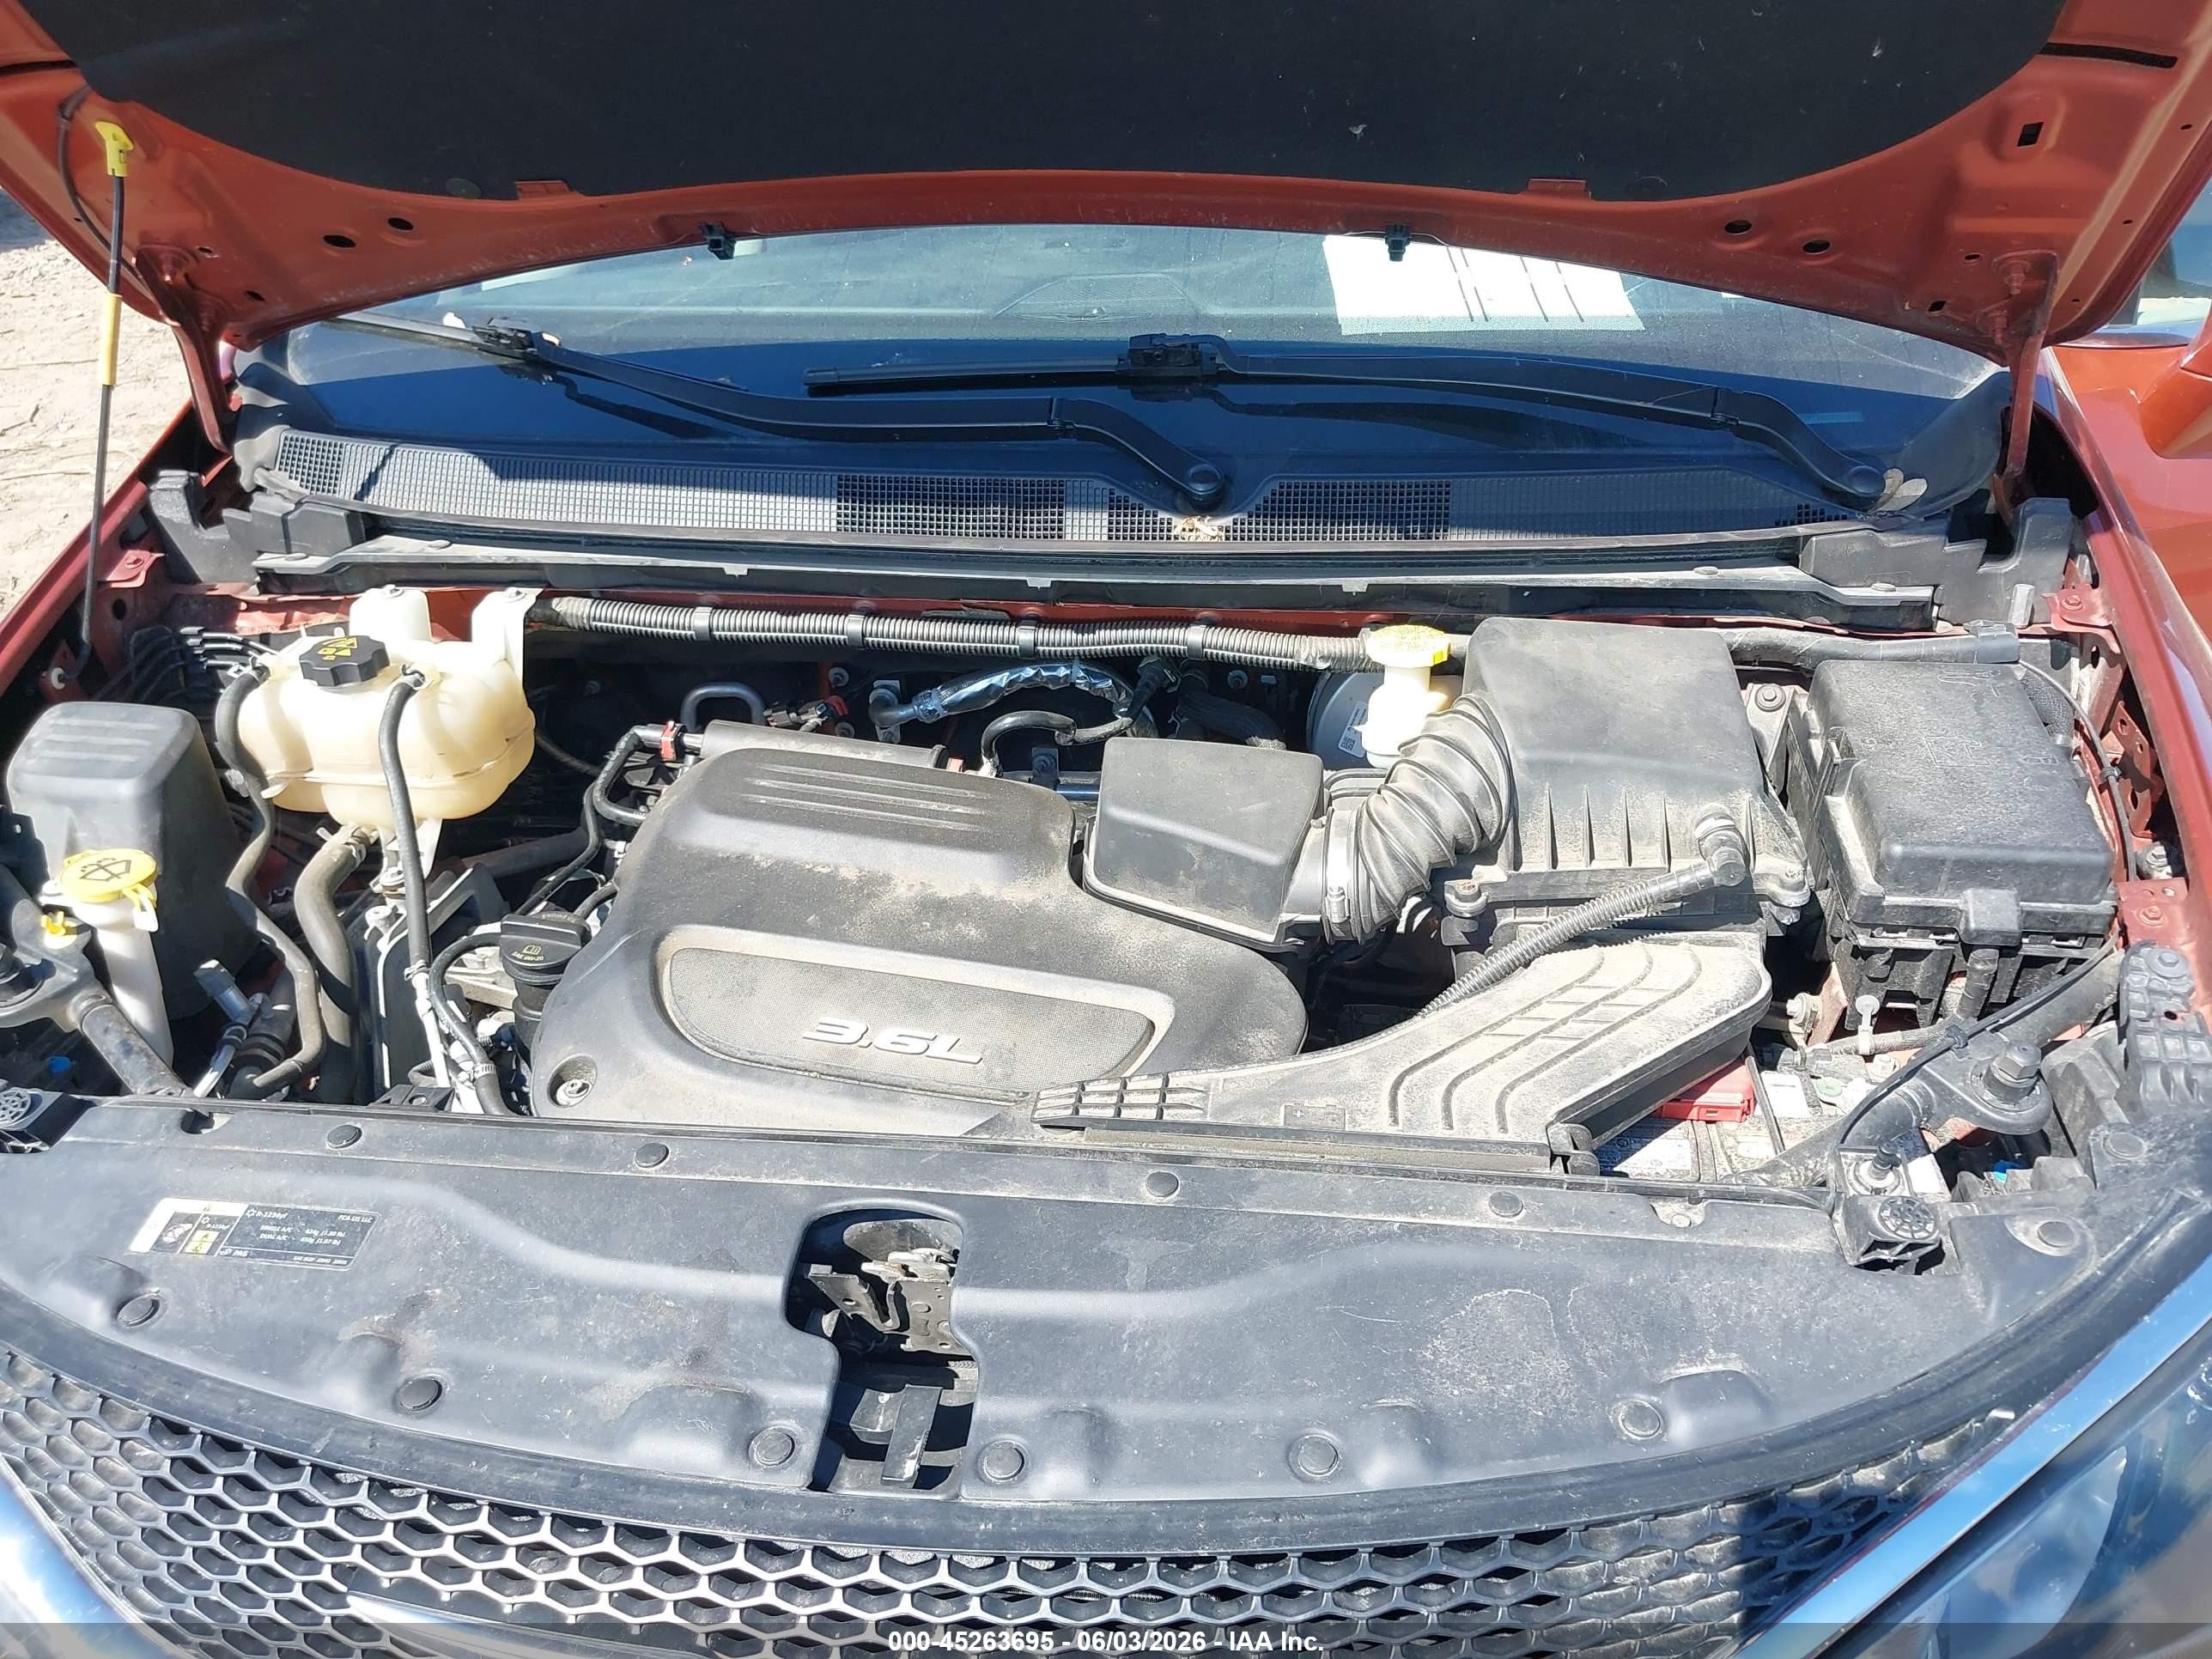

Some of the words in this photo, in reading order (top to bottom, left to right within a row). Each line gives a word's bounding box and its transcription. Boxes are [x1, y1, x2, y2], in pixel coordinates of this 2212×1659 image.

[511, 951, 525, 959] SAE
[801, 1017, 983, 1065] 3.6L
[256, 1210, 289, 1220] R-1234yf
